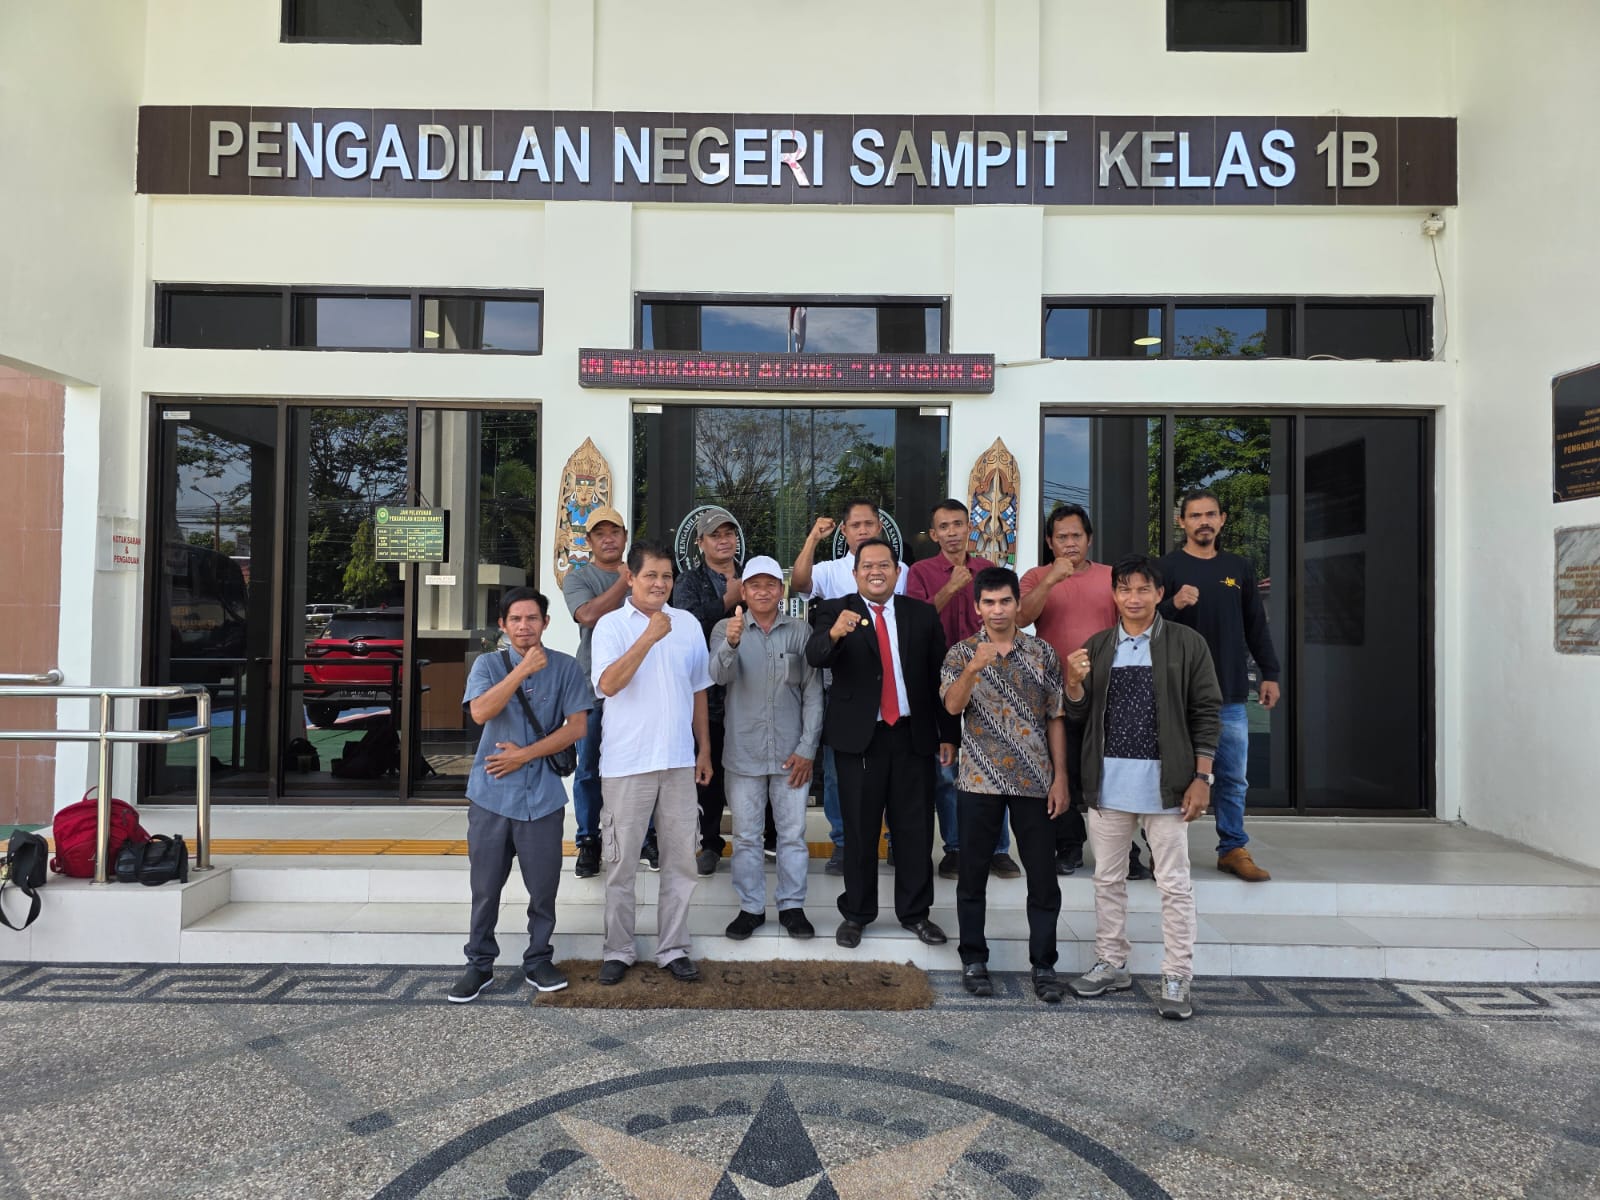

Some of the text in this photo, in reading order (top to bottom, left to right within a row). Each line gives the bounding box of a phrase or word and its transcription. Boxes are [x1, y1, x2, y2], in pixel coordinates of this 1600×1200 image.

[207, 120, 1381, 188] PENGADILAN NEGERI SAMPIT KELAS 1B
[112, 535, 141, 545] KOTAK SARAN
[114, 554, 139, 564] PENGADUAN
